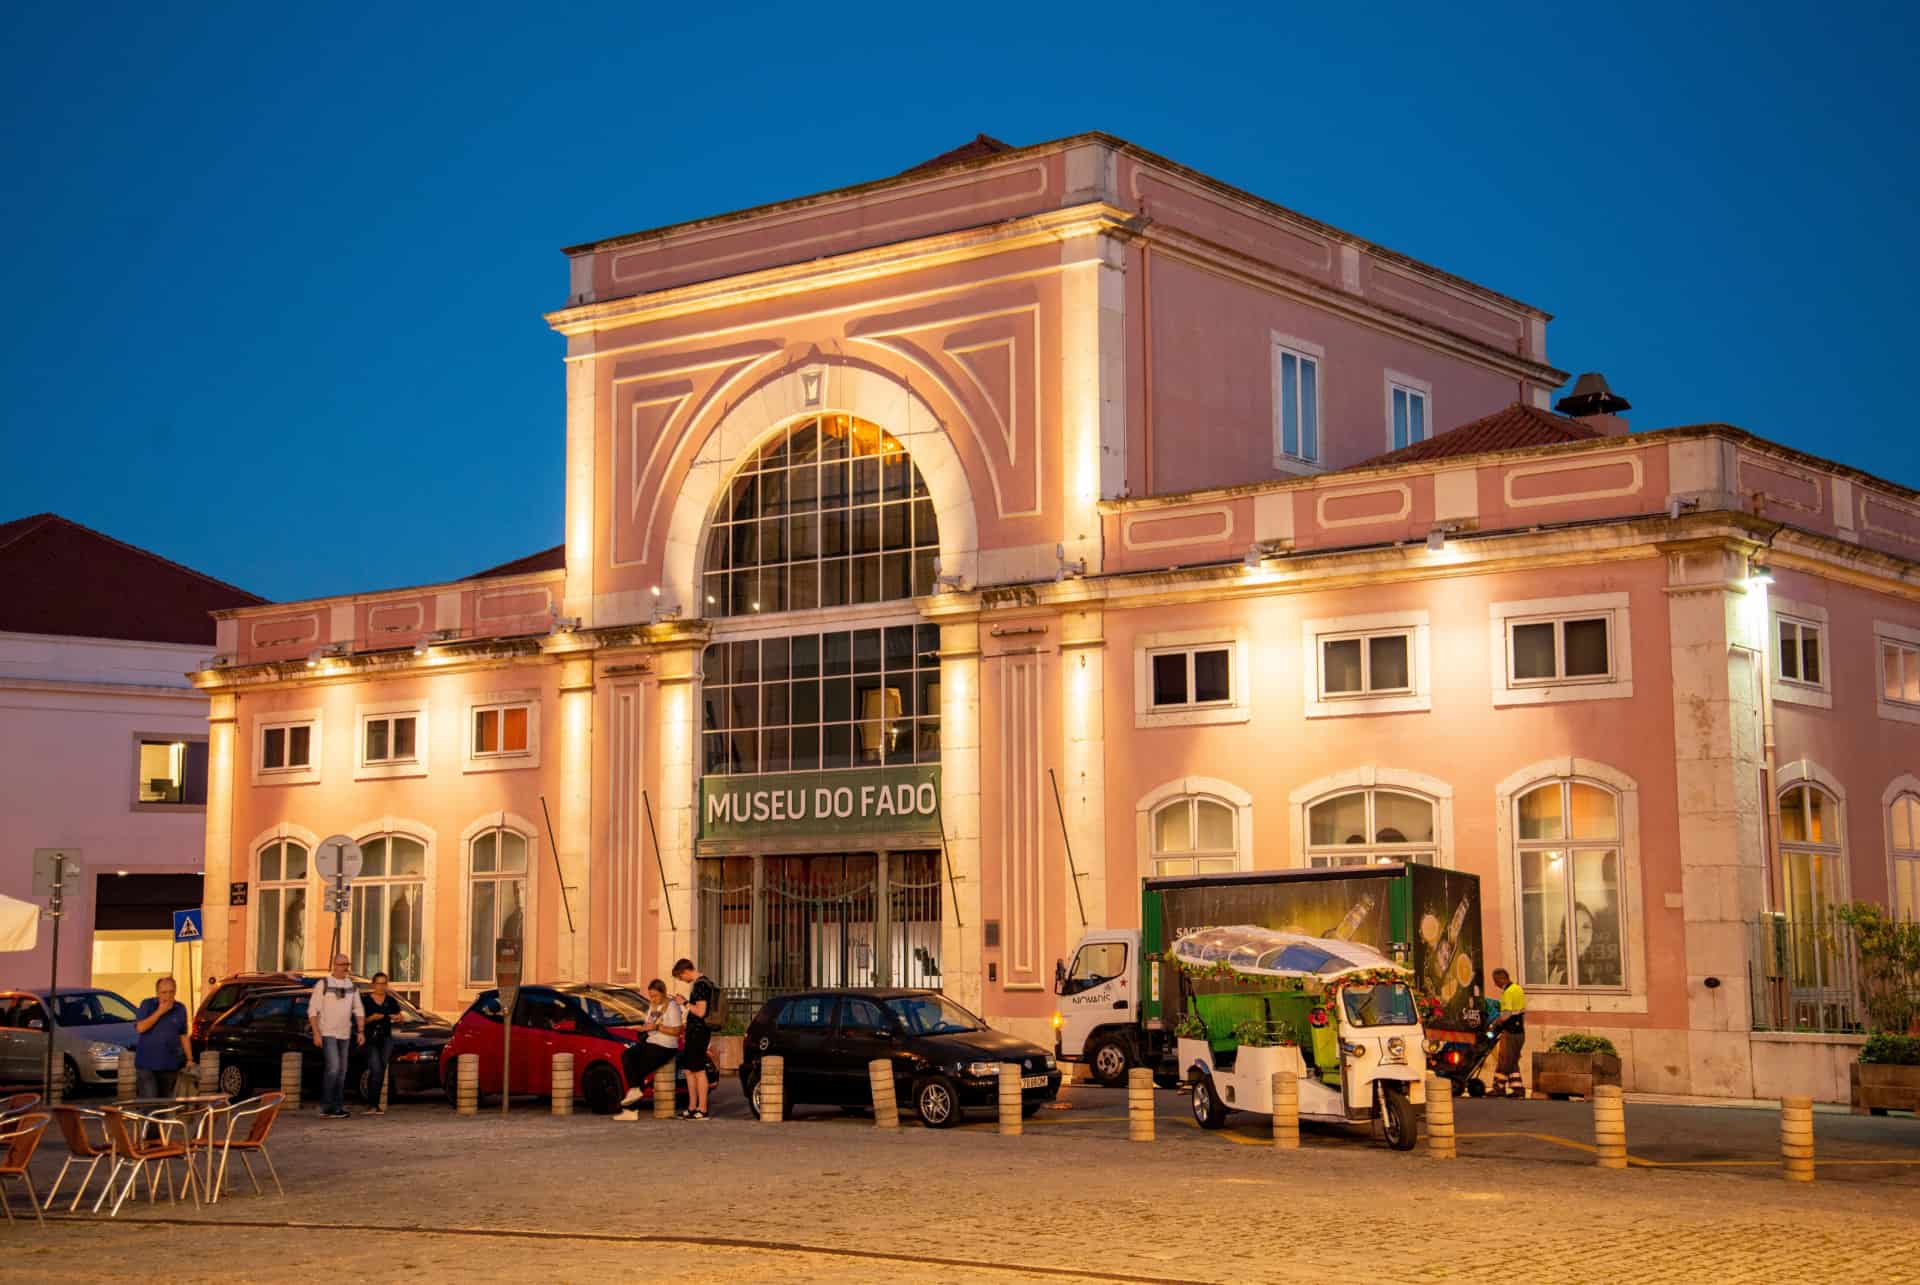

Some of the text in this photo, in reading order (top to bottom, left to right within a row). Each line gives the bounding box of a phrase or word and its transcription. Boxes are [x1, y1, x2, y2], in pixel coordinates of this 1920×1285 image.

[707, 782, 937, 824] MUSEU DO FADO
